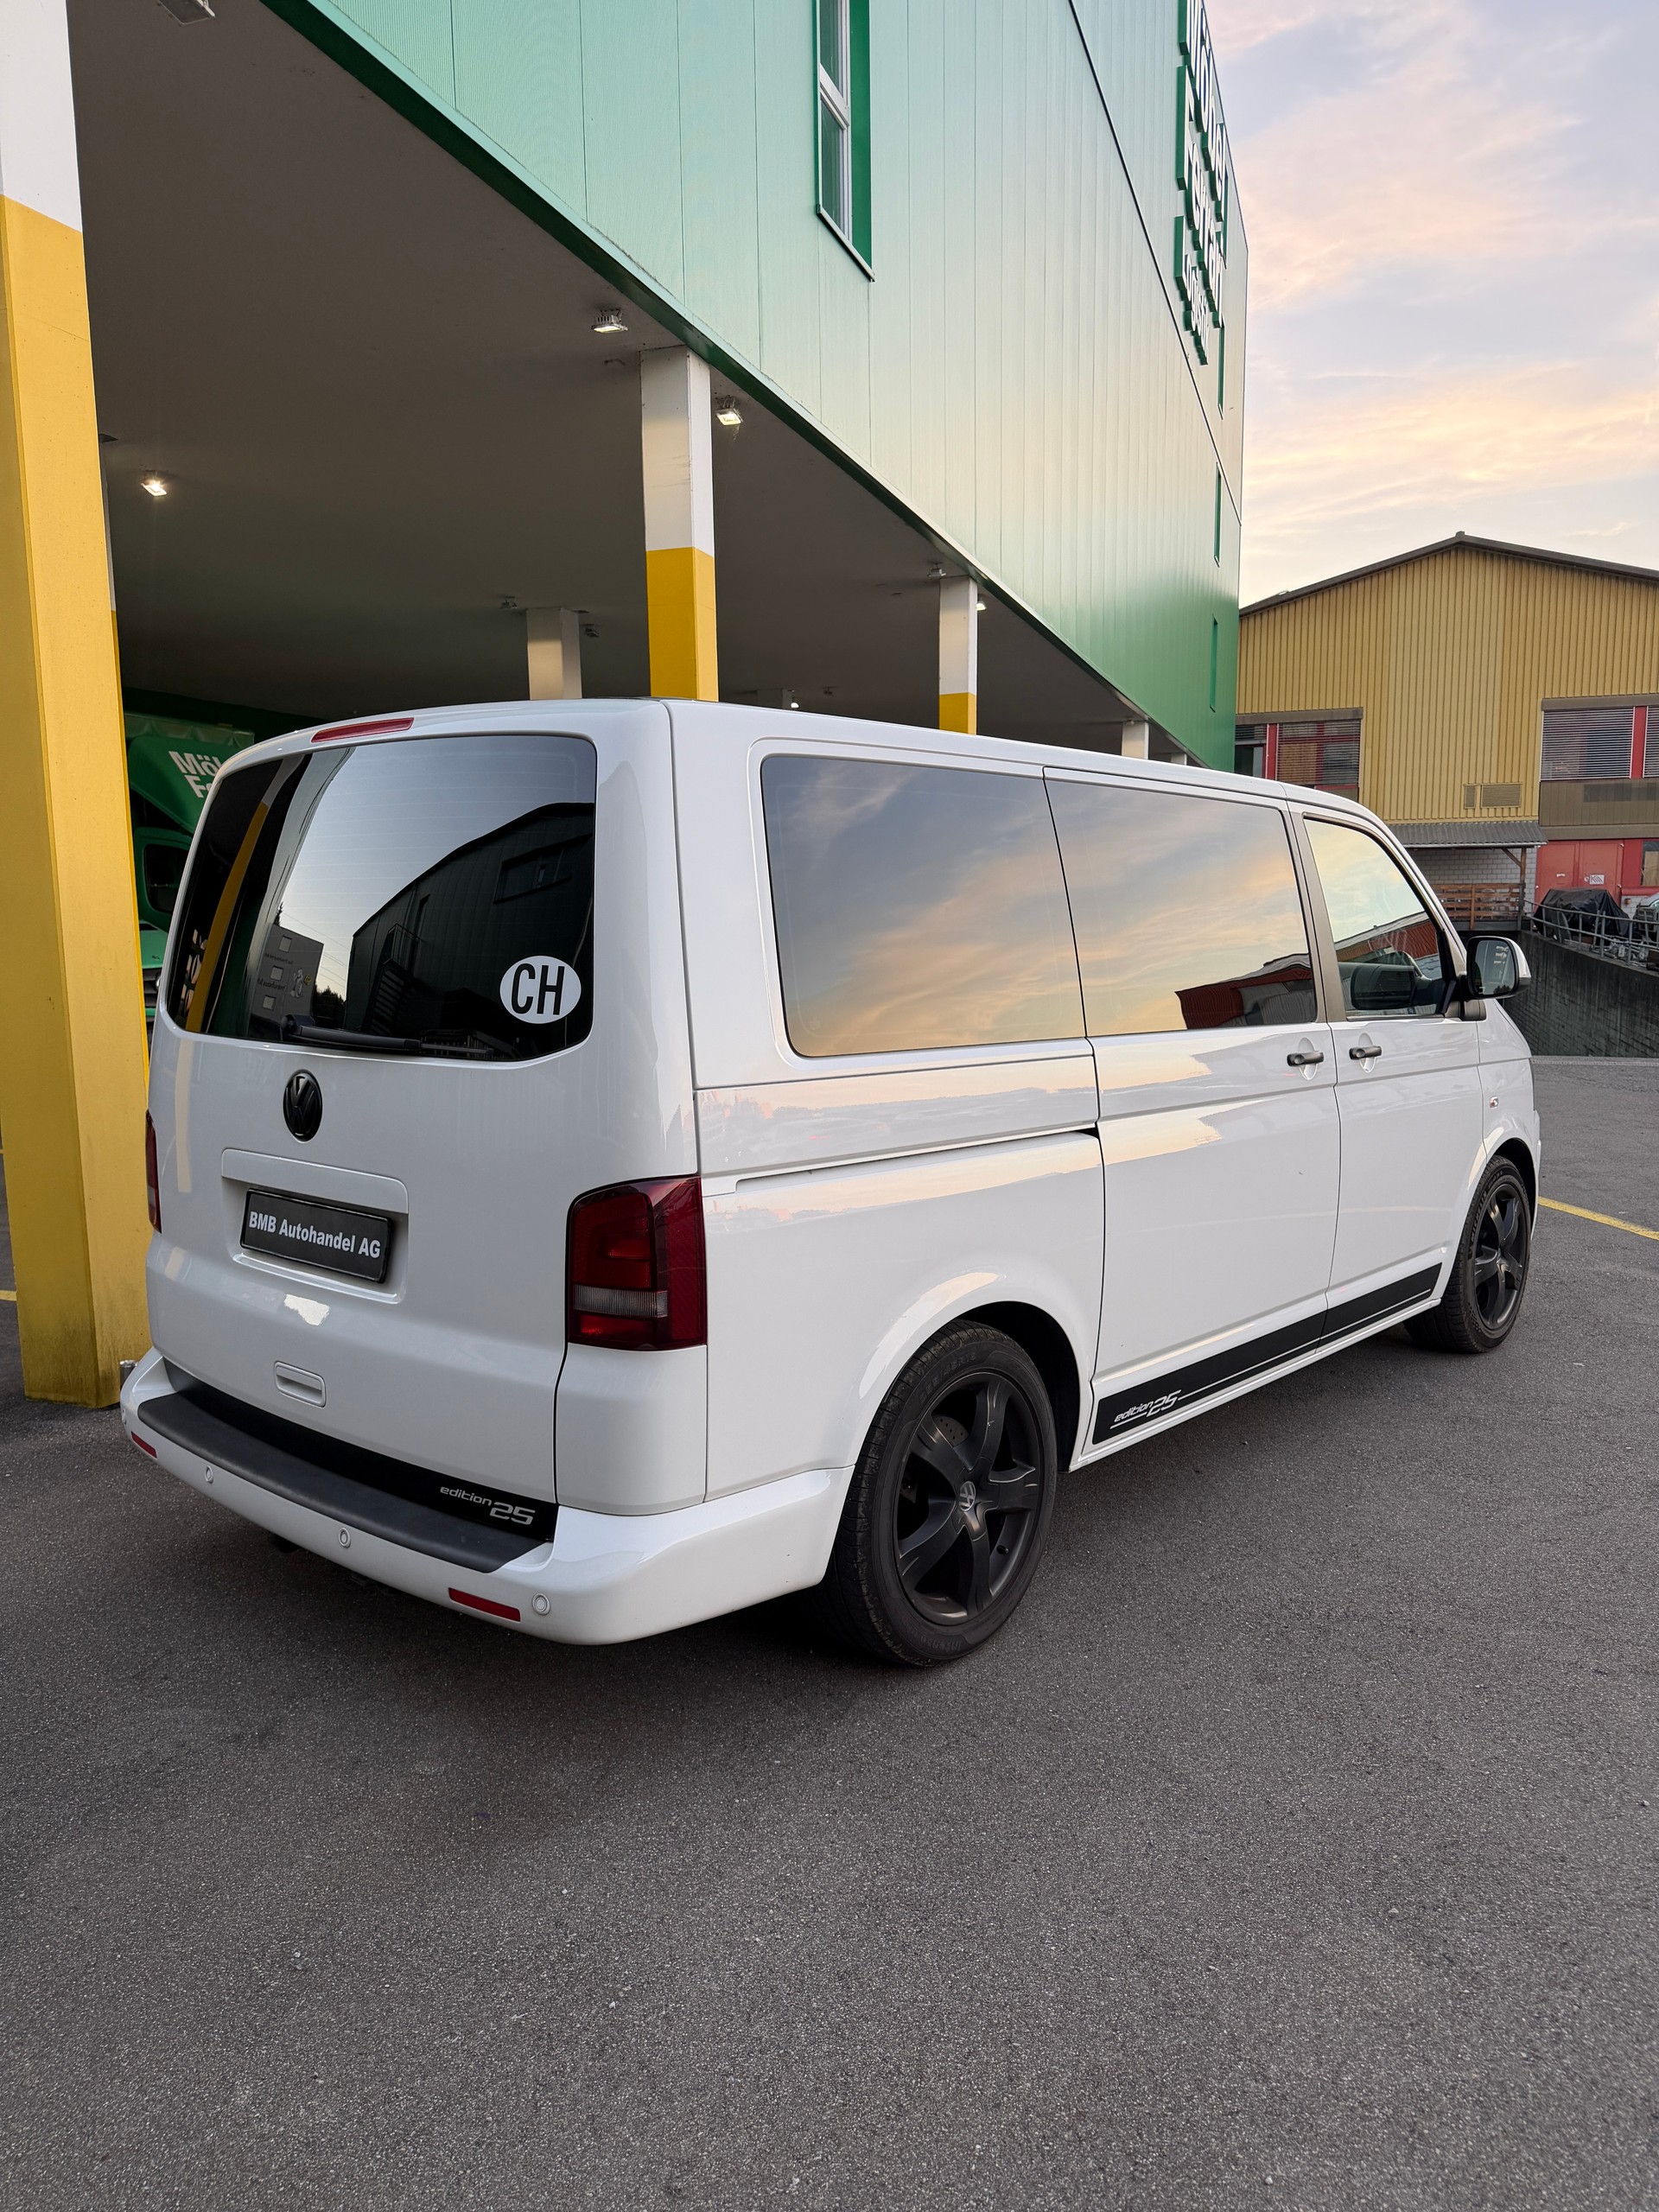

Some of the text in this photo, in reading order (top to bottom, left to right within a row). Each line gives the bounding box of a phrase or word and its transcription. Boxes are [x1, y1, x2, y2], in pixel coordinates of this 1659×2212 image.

[1184, 67, 1224, 327] Ferrari
[1182, 216, 1210, 364] Logistik
[184, 774, 213, 798] F
[511, 963, 565, 1015] CH
[249, 1211, 381, 1259] BMB Autohandel AG
[1114, 1389, 1182, 1422] edition 25
[440, 1486, 536, 1525] edition 25
